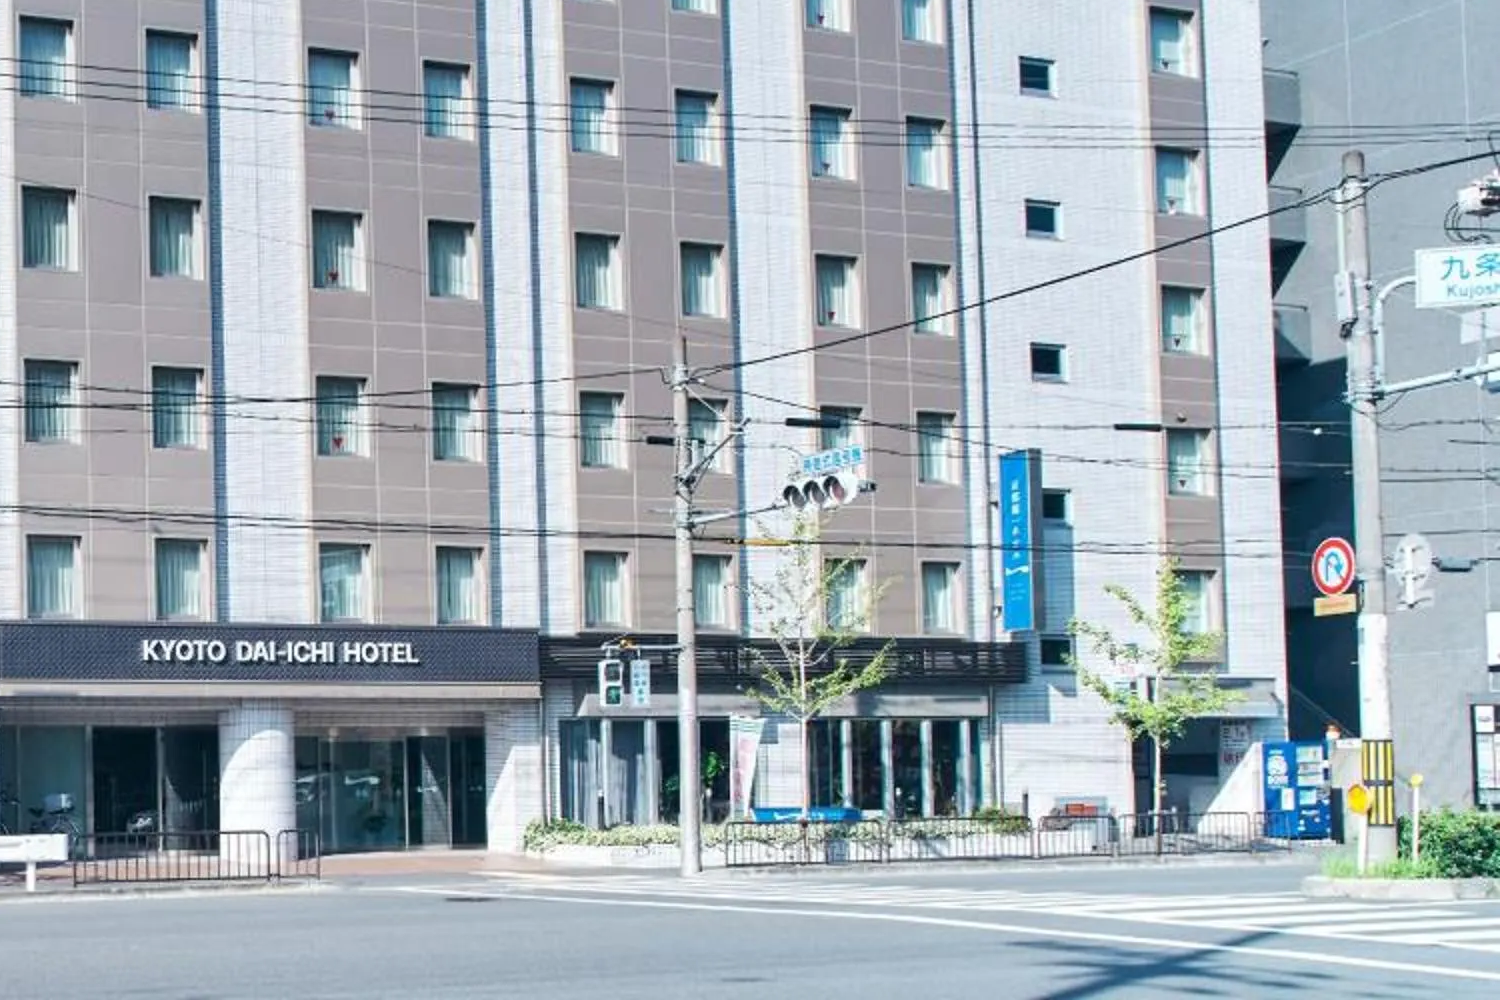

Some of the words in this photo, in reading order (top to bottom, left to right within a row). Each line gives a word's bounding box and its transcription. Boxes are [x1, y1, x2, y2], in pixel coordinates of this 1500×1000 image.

[141, 639, 227, 662] KYOTO
[235, 640, 335, 663] DAI-ICHI
[343, 641, 420, 664] HOTEL
